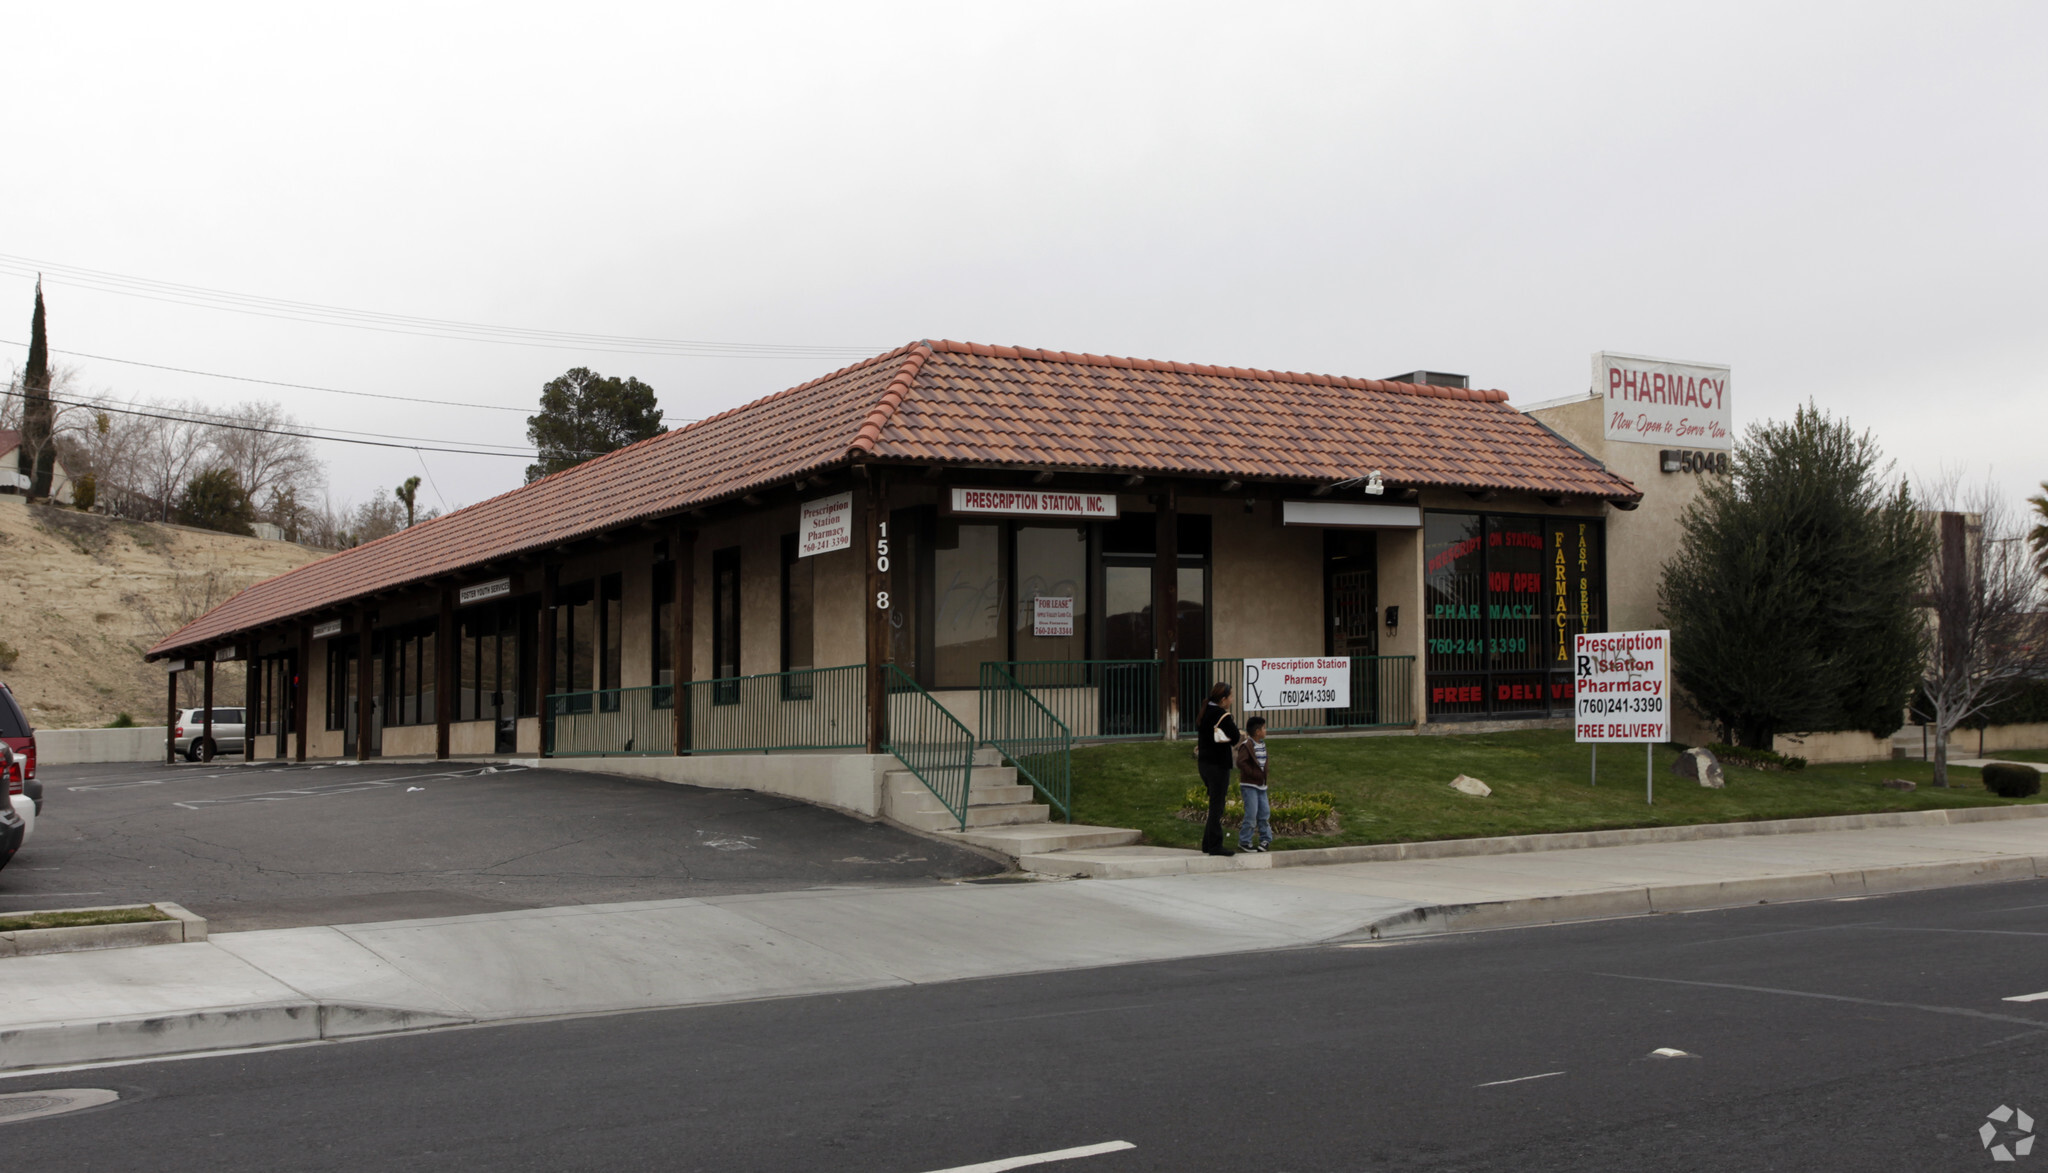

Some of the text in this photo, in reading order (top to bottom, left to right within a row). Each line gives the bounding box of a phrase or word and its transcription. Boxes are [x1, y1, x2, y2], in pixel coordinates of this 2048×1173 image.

[1609, 367, 1724, 410] PHARMACY
[1610, 411, 1726, 438] Now Open to Serve You
[803, 501, 849, 519] Prescription
[966, 491, 1105, 515] PRESCRIPTION STATION, INC.
[813, 515, 841, 529] Station
[808, 527, 844, 542] Pharmacy
[1505, 532, 1543, 550] STATION
[1578, 523, 1588, 572] FAST
[461, 581, 510, 600] FOSTER YOUTH SERVICES
[1488, 572, 1541, 593] NOW OPEN
[1555, 532, 1568, 661] FARMACIA
[1576, 632, 1663, 655] Prescription
[1261, 658, 1347, 671] Prescription Station
[1599, 659, 1654, 672] Station
[1284, 674, 1328, 686] Pharmacy
[1577, 679, 1662, 695] Pharmacy
[1279, 689, 1336, 706] (760)241-3390
[1432, 686, 1482, 703] FREE
[1578, 697, 1663, 717] (760)241-3390
[1577, 723, 1663, 738] FREE DELIVERY
